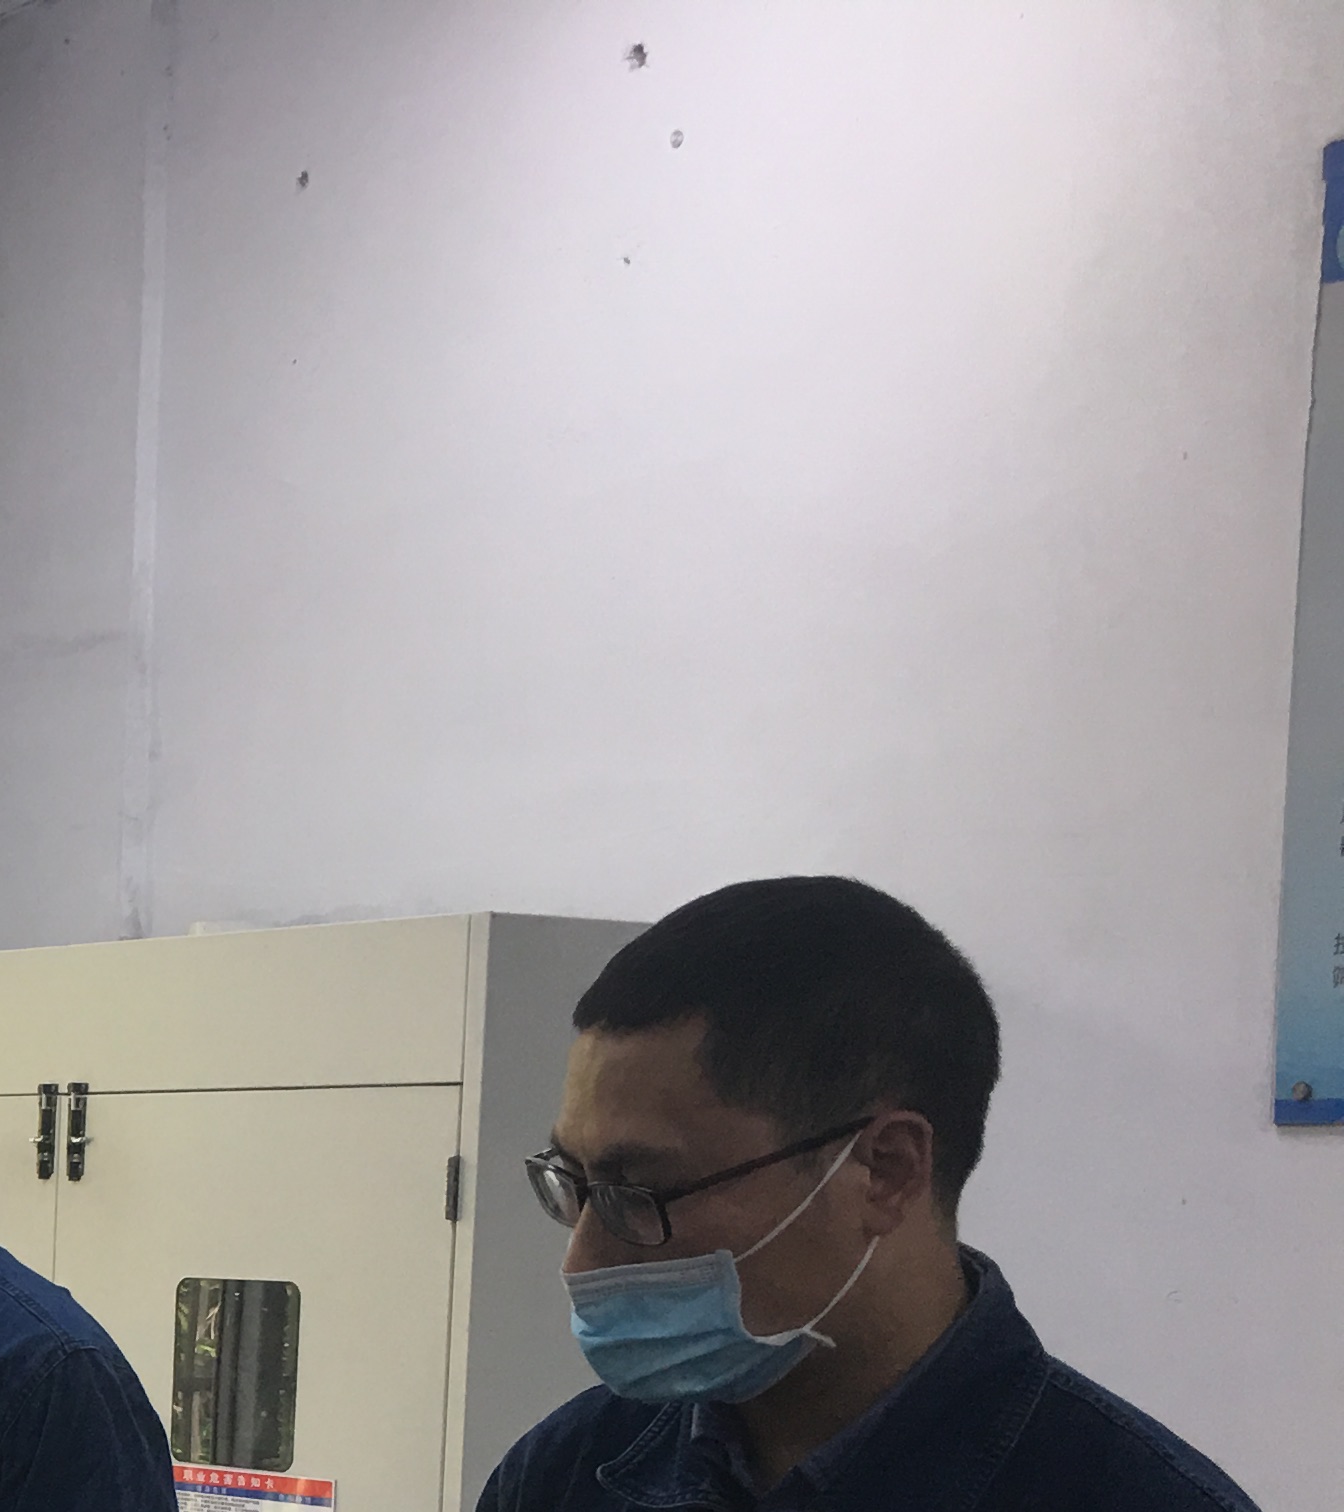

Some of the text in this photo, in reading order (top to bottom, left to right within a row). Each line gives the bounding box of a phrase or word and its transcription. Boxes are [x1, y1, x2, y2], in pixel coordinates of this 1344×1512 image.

[183, 1470, 275, 1489] 职业危害告知卡
